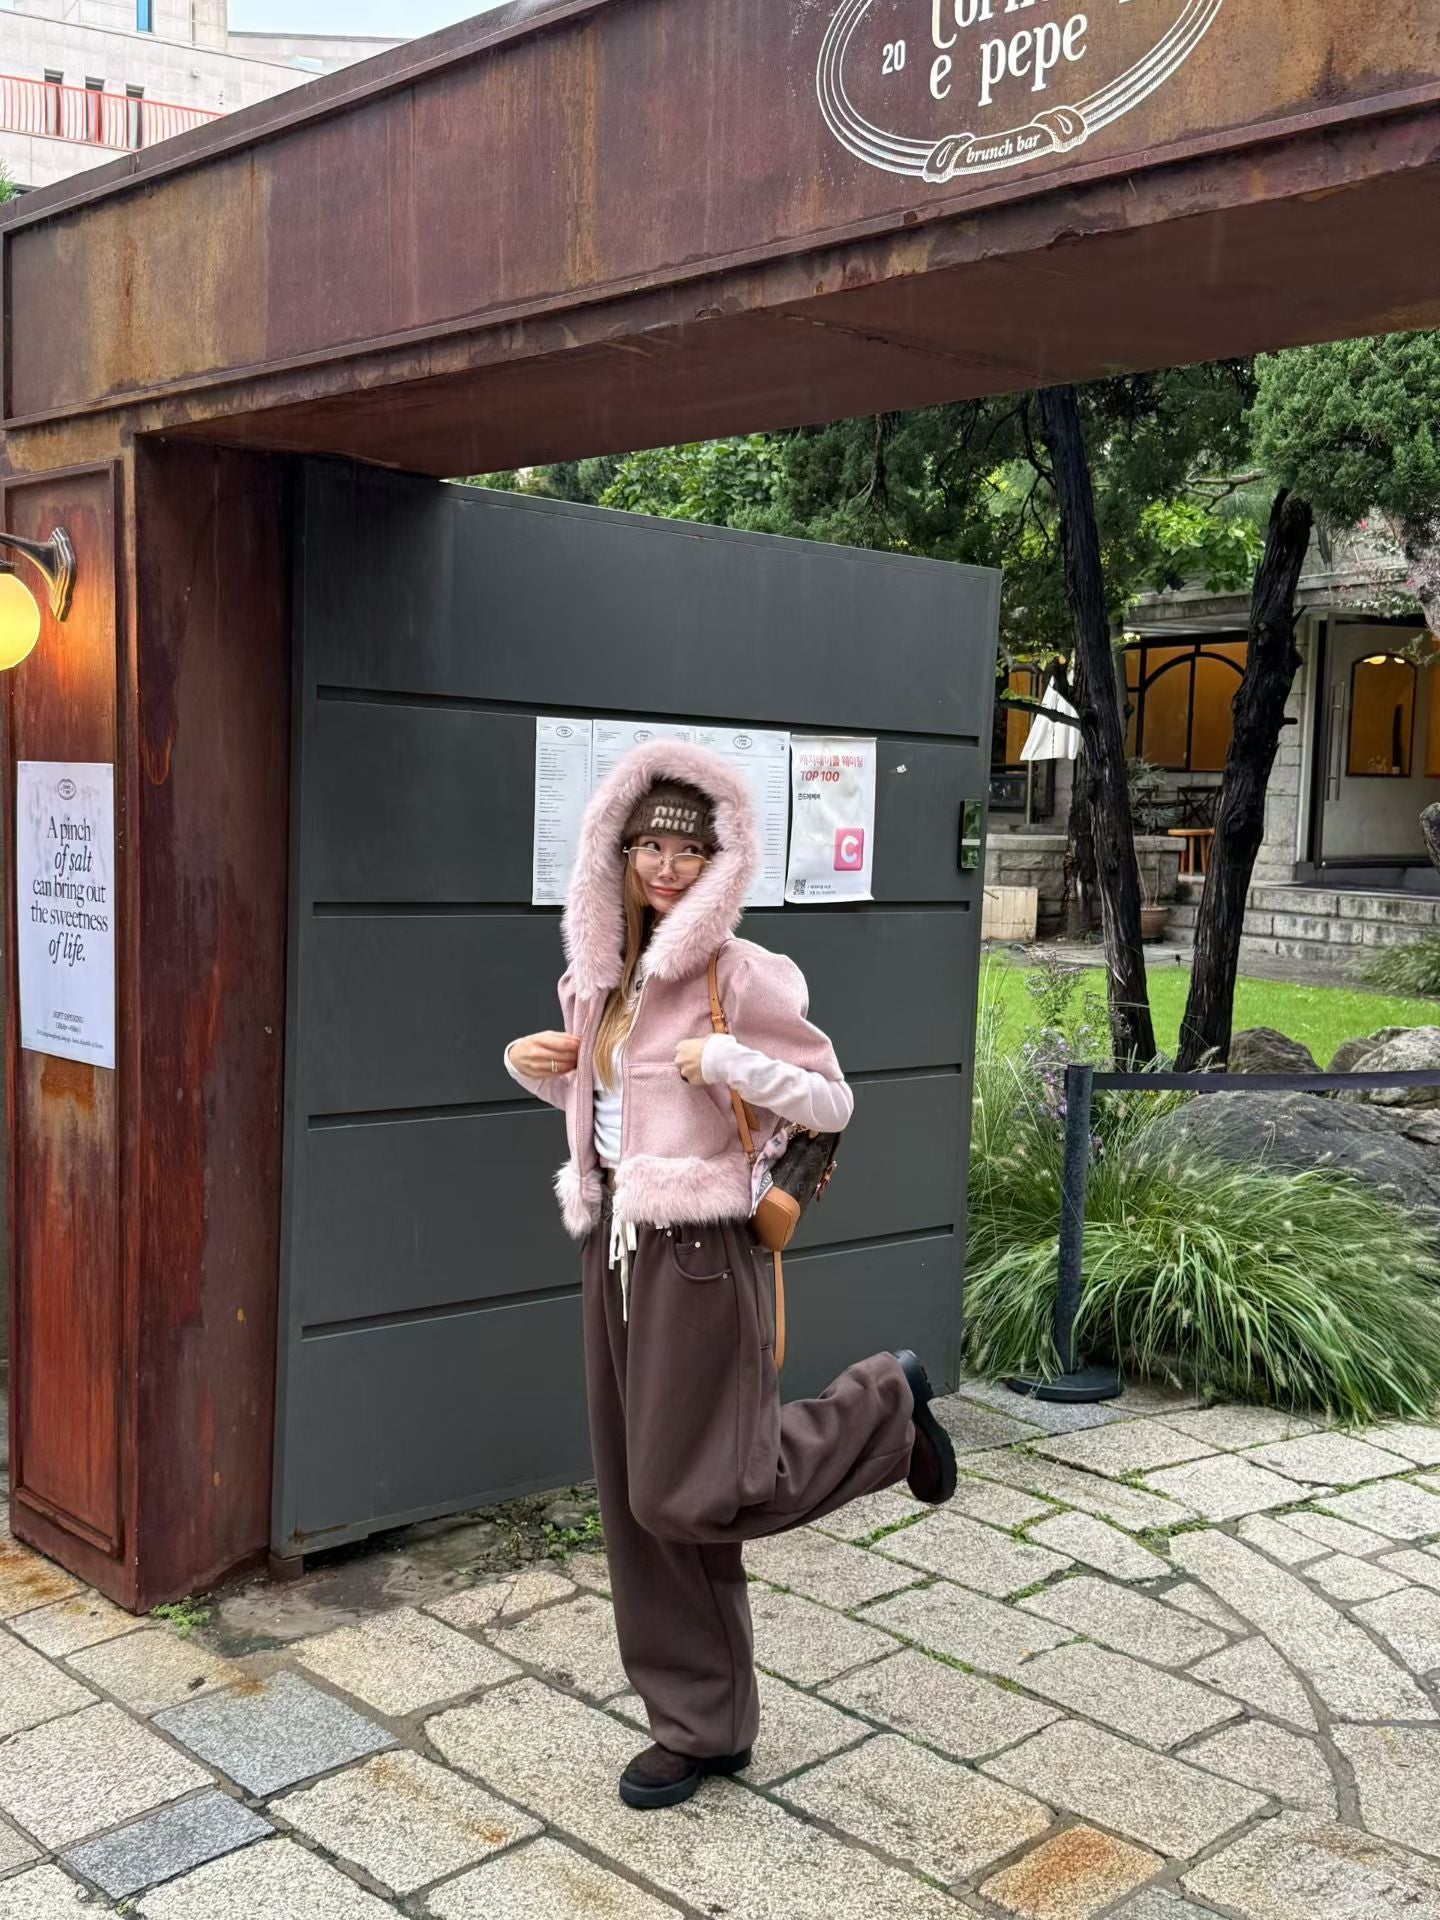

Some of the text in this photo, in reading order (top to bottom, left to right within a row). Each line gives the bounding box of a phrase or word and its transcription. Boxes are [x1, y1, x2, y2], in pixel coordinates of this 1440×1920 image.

[881, 39, 906, 76] 20
[929, 14, 1087, 107] e pepe
[966, 133, 1041, 163] brunch bar
[800, 770, 840, 782] TOP 100
[47, 815, 91, 847] A pinch
[54, 843, 93, 877] of salt
[841, 835, 860, 864] C
[32, 874, 107, 908] can bring out
[31, 900, 109, 932] the sweetness
[48, 931, 86, 967] of life.
